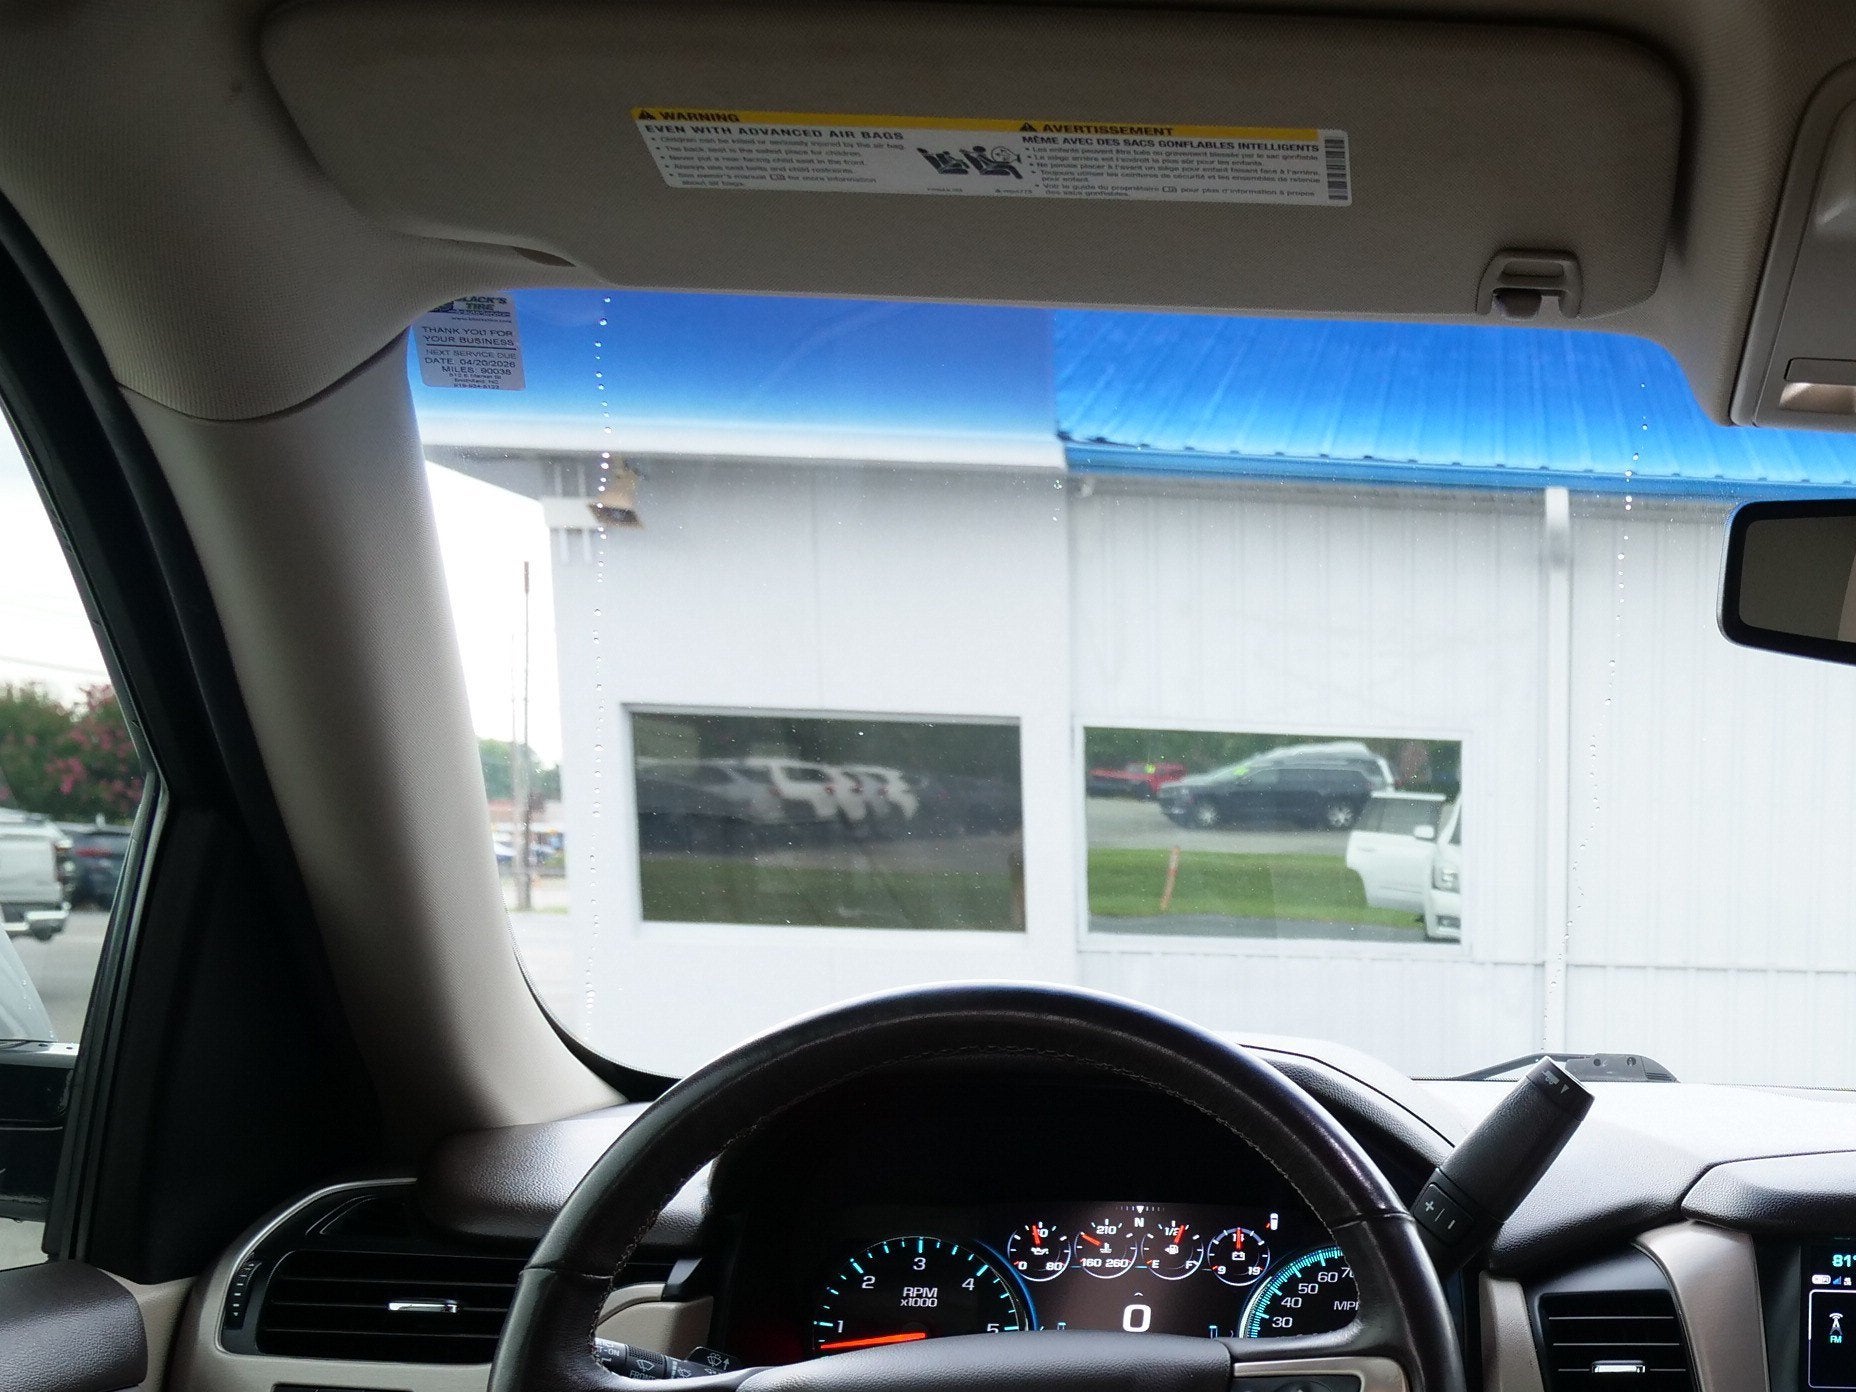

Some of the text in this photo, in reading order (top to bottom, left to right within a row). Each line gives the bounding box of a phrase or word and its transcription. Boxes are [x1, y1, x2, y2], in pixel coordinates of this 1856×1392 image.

[660, 112, 740, 122] WARNING
[691, 126, 732, 134] WITH
[738, 127, 823, 136] ADVANCED
[1042, 124, 1172, 136] AVERTISSEMENT
[1022, 134, 1318, 151] MÊME AVEC DES SACS GONFLABLES INTELLIGENTS
[422, 326, 460, 334] THANK
[462, 328, 487, 336] YOU
[460, 337, 515, 346] BUSINESS
[453, 350, 492, 358] SERVICE
[496, 352, 517, 360] DUE
[1134, 1218, 1144, 1228] N
[1096, 1226, 1117, 1235] 210
[912, 1256, 926, 1270] 3
[1046, 1262, 1063, 1271] 80
[1106, 1259, 1129, 1268] 260
[1152, 1260, 1160, 1269] E
[1217, 1265, 1226, 1274] 9
[861, 1275, 876, 1289] 2
[1318, 1272, 1338, 1283] 60
[962, 1278, 975, 1291] 4
[1298, 1283, 1318, 1294] 50
[902, 1286, 938, 1298] RPM
[900, 1298, 938, 1308] x1000
[1280, 1296, 1302, 1308] 40
[1122, 1304, 1151, 1332] 0
[1272, 1316, 1293, 1328] 30
[836, 1320, 844, 1333] 1
[986, 1323, 999, 1334] 5
[1830, 1334, 1842, 1344] FM
